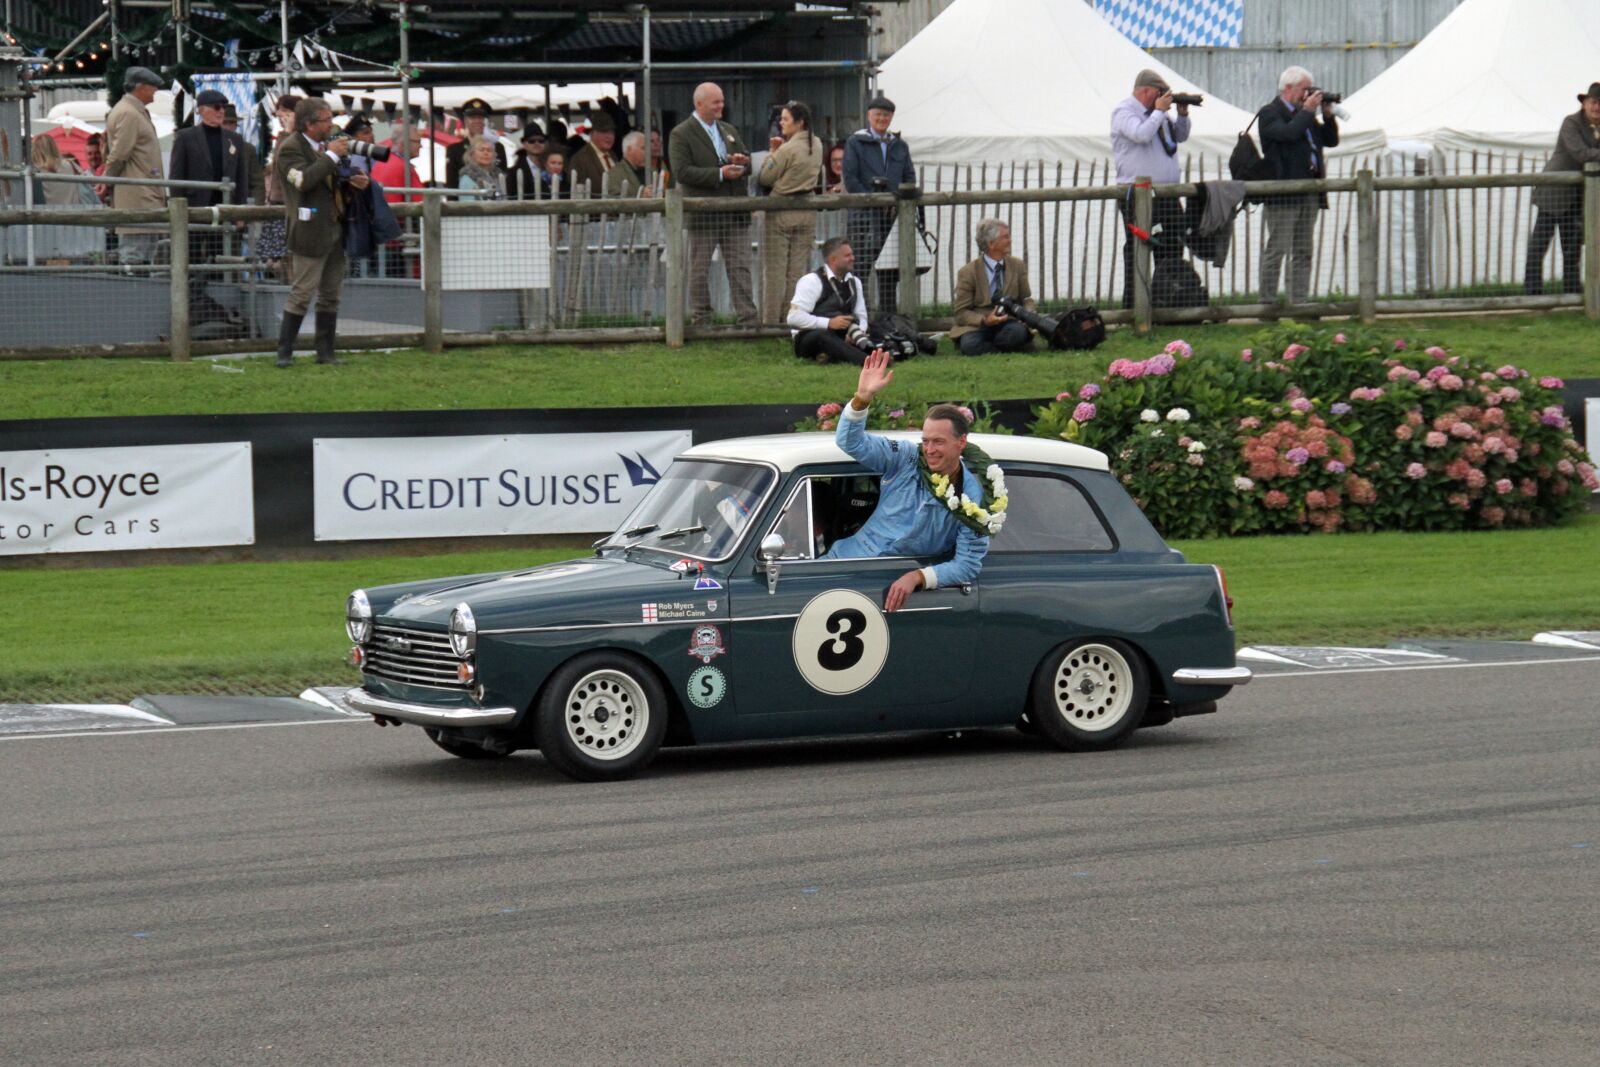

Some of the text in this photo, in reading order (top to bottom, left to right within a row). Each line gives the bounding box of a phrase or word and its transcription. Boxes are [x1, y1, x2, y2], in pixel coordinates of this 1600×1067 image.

[0, 465, 160, 509] ls-Royce
[342, 468, 622, 512] CREDIT SUISSE
[74, 514, 160, 537] Cars
[658, 602, 695, 611] Rob Myers
[658, 610, 685, 618] Michael
[817, 607, 867, 671] 3
[701, 674, 714, 697] S
